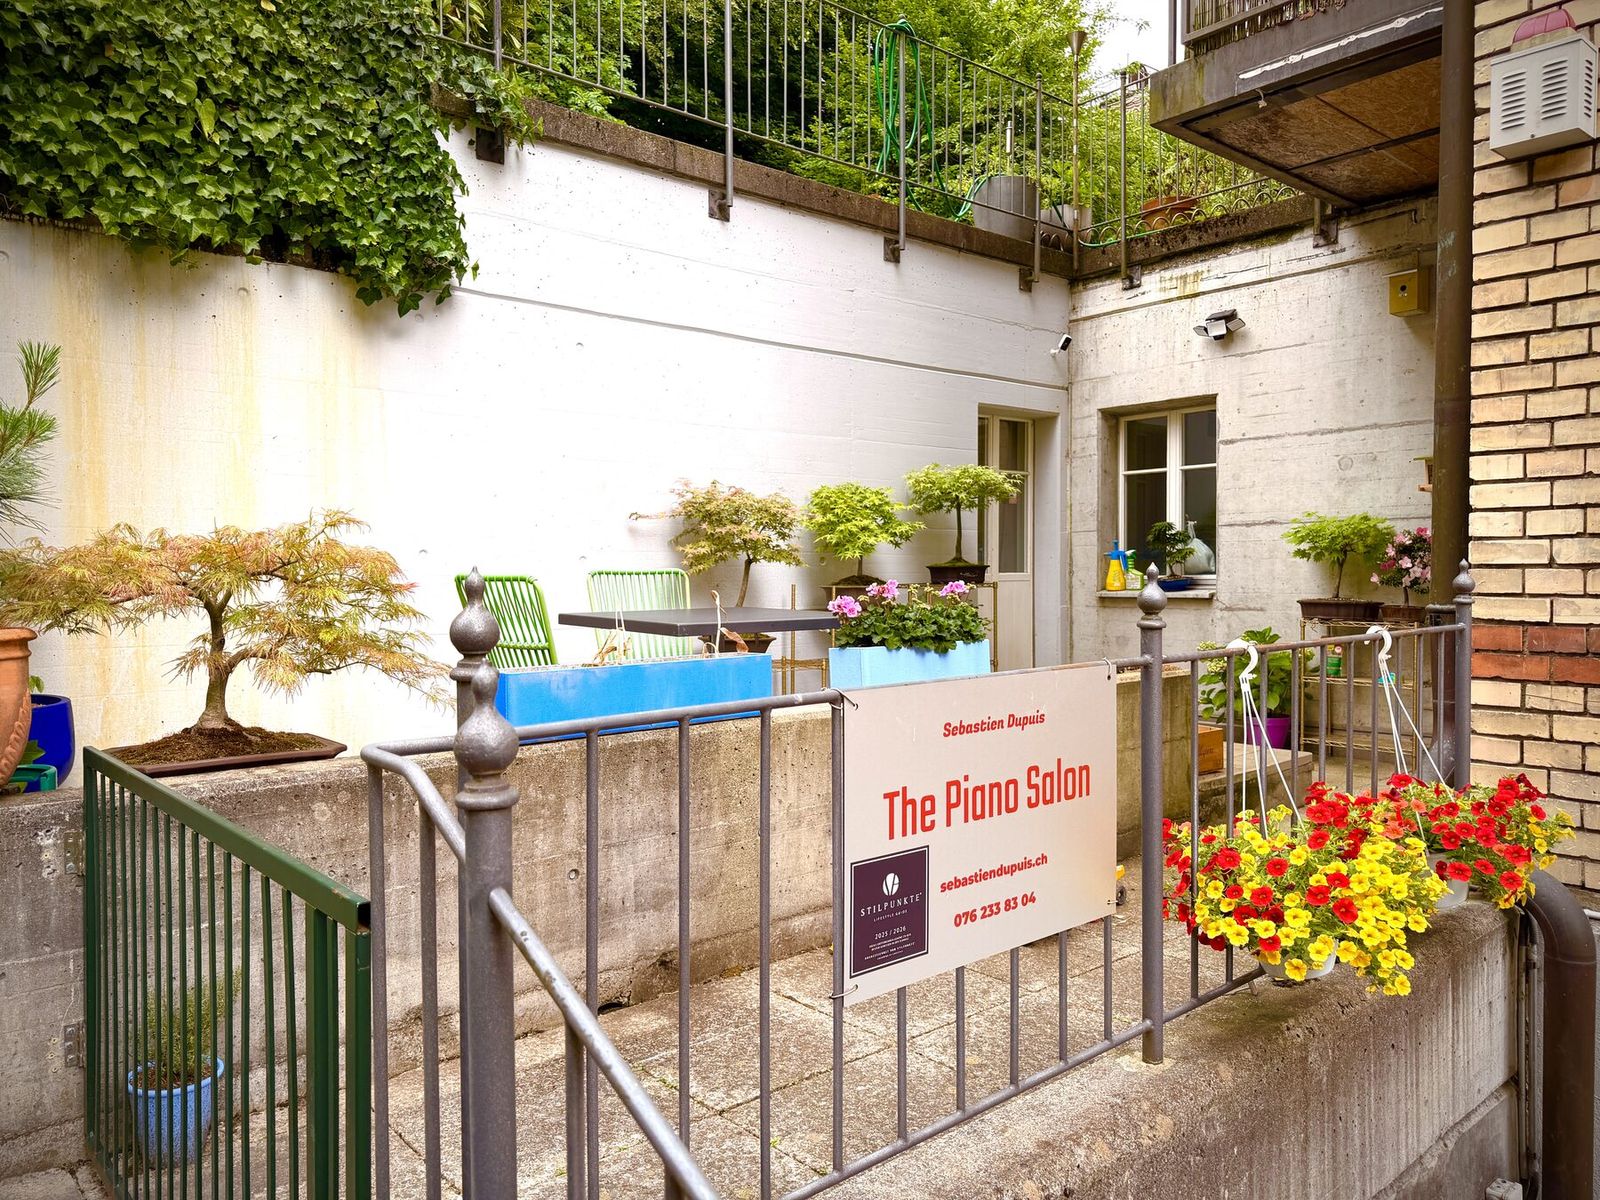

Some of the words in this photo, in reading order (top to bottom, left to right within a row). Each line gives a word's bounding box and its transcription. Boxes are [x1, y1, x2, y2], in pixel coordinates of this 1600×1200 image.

[942, 716, 1004, 738] Sebastien
[1007, 709, 1046, 732] Dupuis
[883, 785, 936, 841] The
[945, 774, 1019, 828] Piano
[1027, 757, 1091, 809] Salon
[940, 853, 1048, 893] sebastiendupuis.ch
[953, 907, 977, 928] 076
[980, 901, 1001, 921] 233
[1004, 896, 1019, 912] 83
[1021, 891, 1037, 907] 04
[874, 929, 889, 940] 2025
[893, 925, 907, 935] 2026
